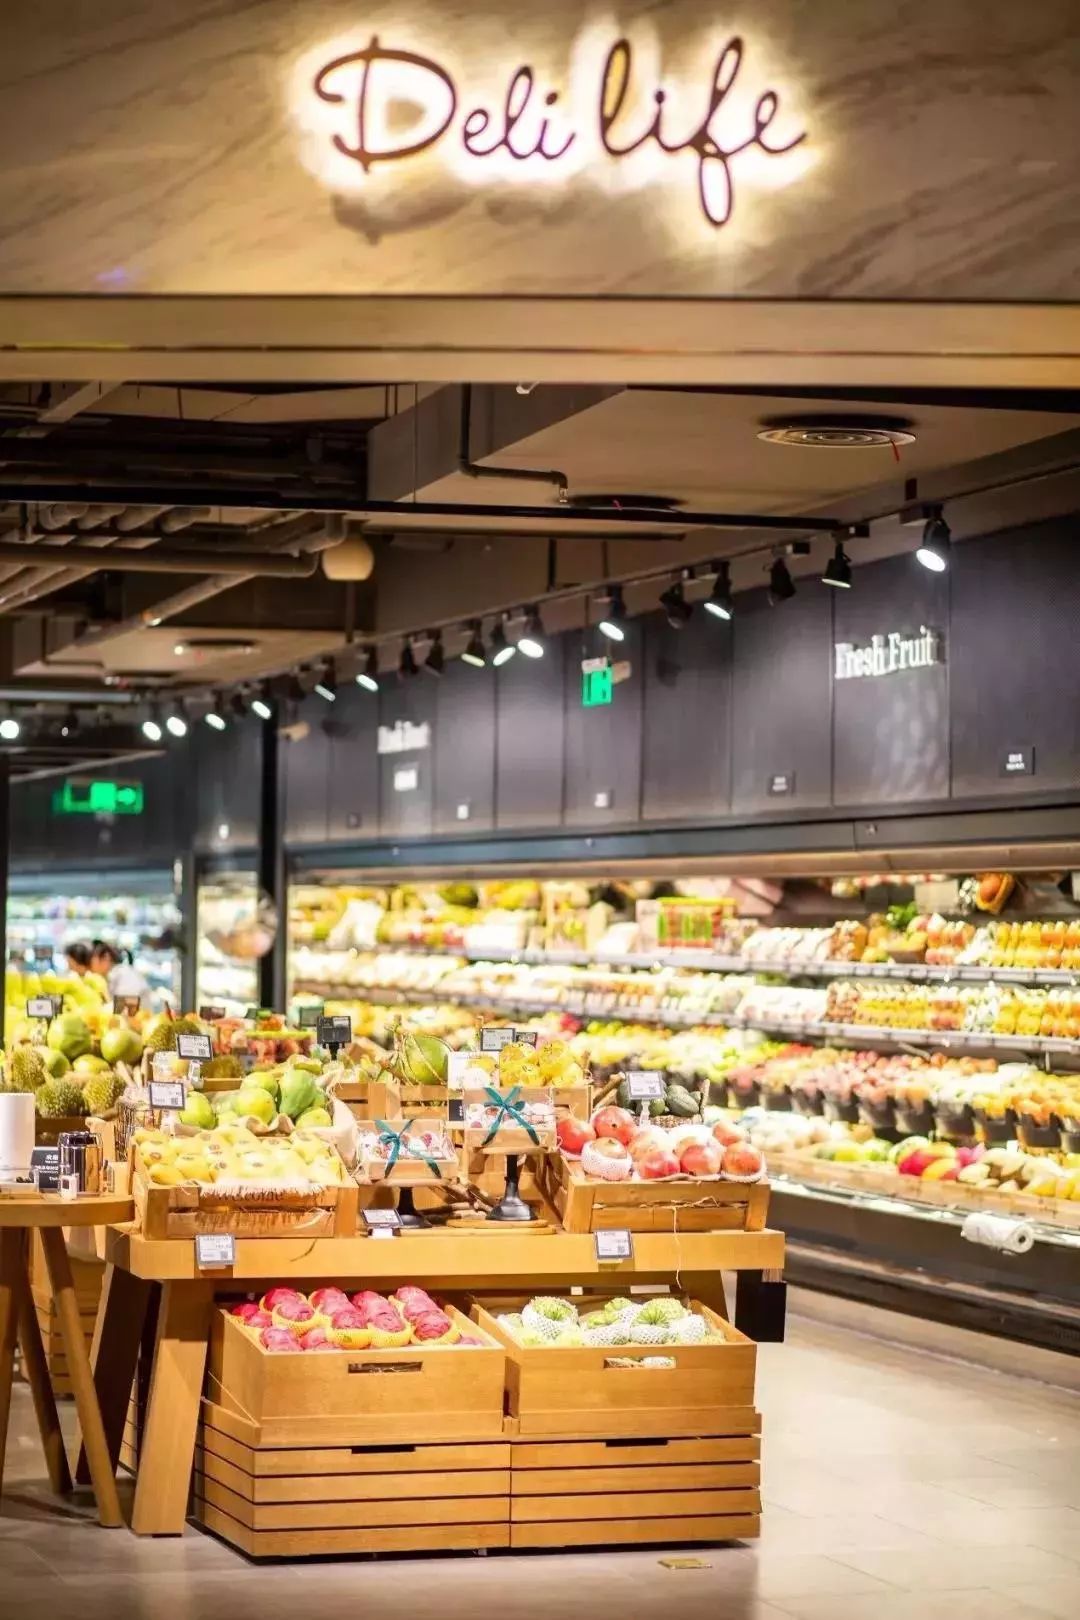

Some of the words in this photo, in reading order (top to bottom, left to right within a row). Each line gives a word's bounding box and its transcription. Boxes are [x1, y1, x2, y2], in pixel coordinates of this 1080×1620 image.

[314, 35, 576, 173] Deli
[600, 37, 807, 226] life
[835, 634, 887, 679] Fresh
[888, 625, 934, 671] Fruit
